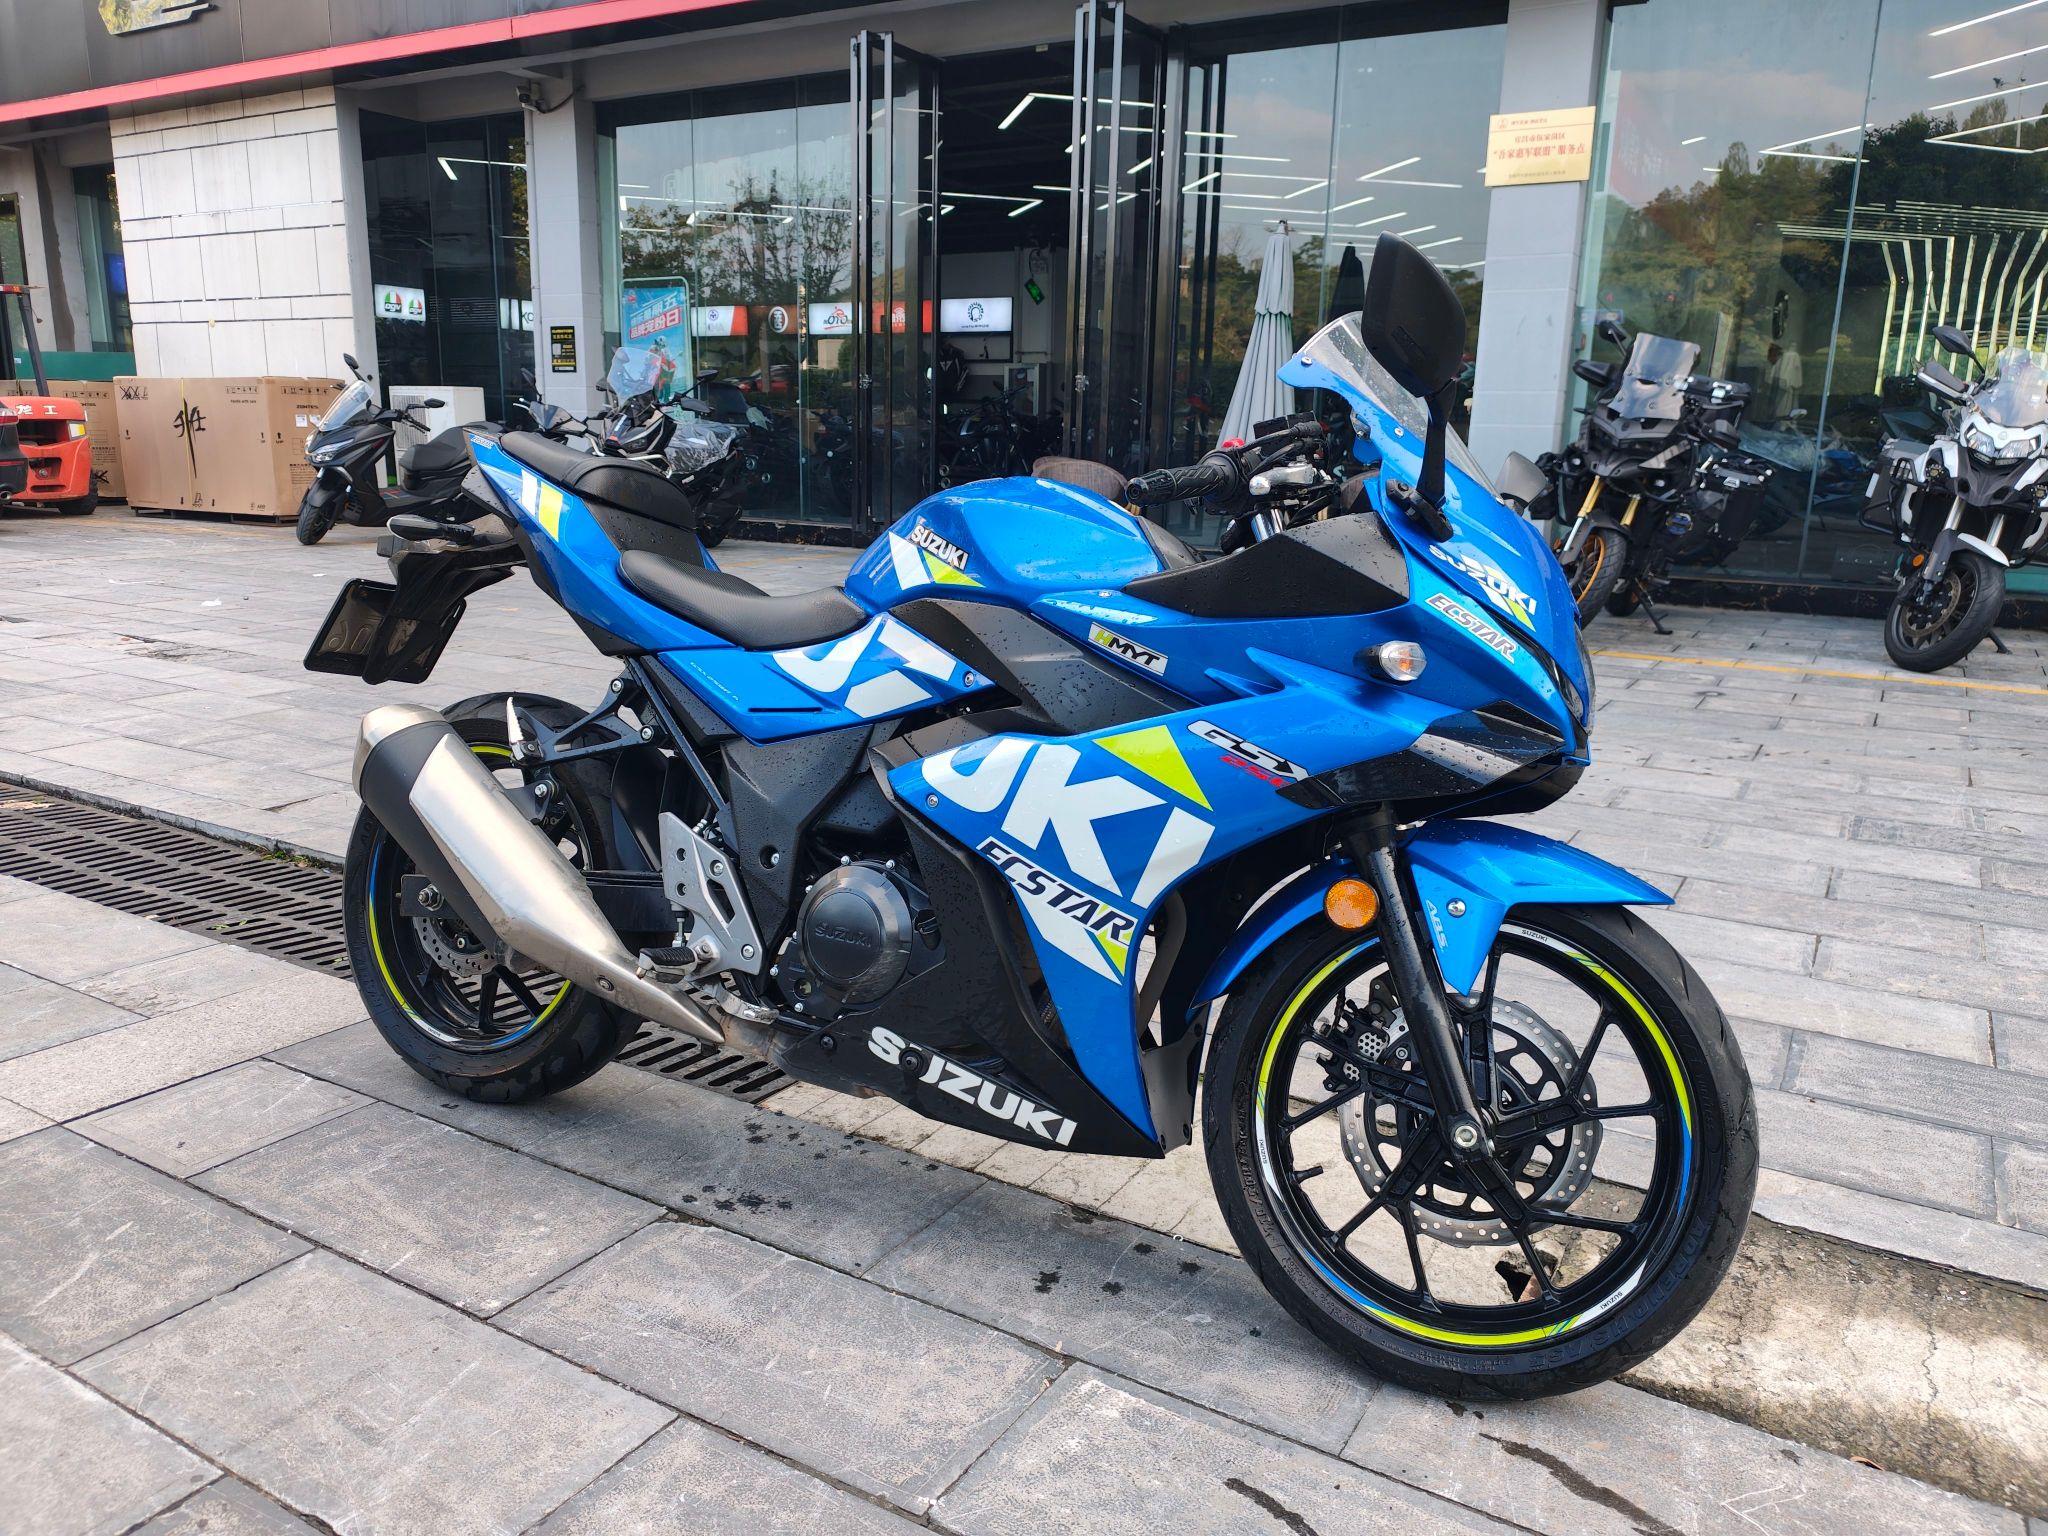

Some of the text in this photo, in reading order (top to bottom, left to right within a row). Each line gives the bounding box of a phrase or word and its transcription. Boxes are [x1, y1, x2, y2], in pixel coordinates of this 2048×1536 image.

[16, 404, 58, 415] 龙工
[911, 525, 969, 569] SUZUKI
[1429, 544, 1537, 616] SUZUKI
[1093, 629, 1161, 669] HMYT
[1425, 593, 1515, 665] ECSTAR
[1188, 719, 1311, 783] GSX
[979, 838, 1139, 946] ECSTAR
[815, 922, 872, 949] SUZUKI
[1425, 899, 1449, 950] ABS
[1521, 929, 1548, 943] SUZUKI
[1259, 1139, 1268, 1165] SUZUKI
[1600, 1291, 1624, 1311] SUZUKI
